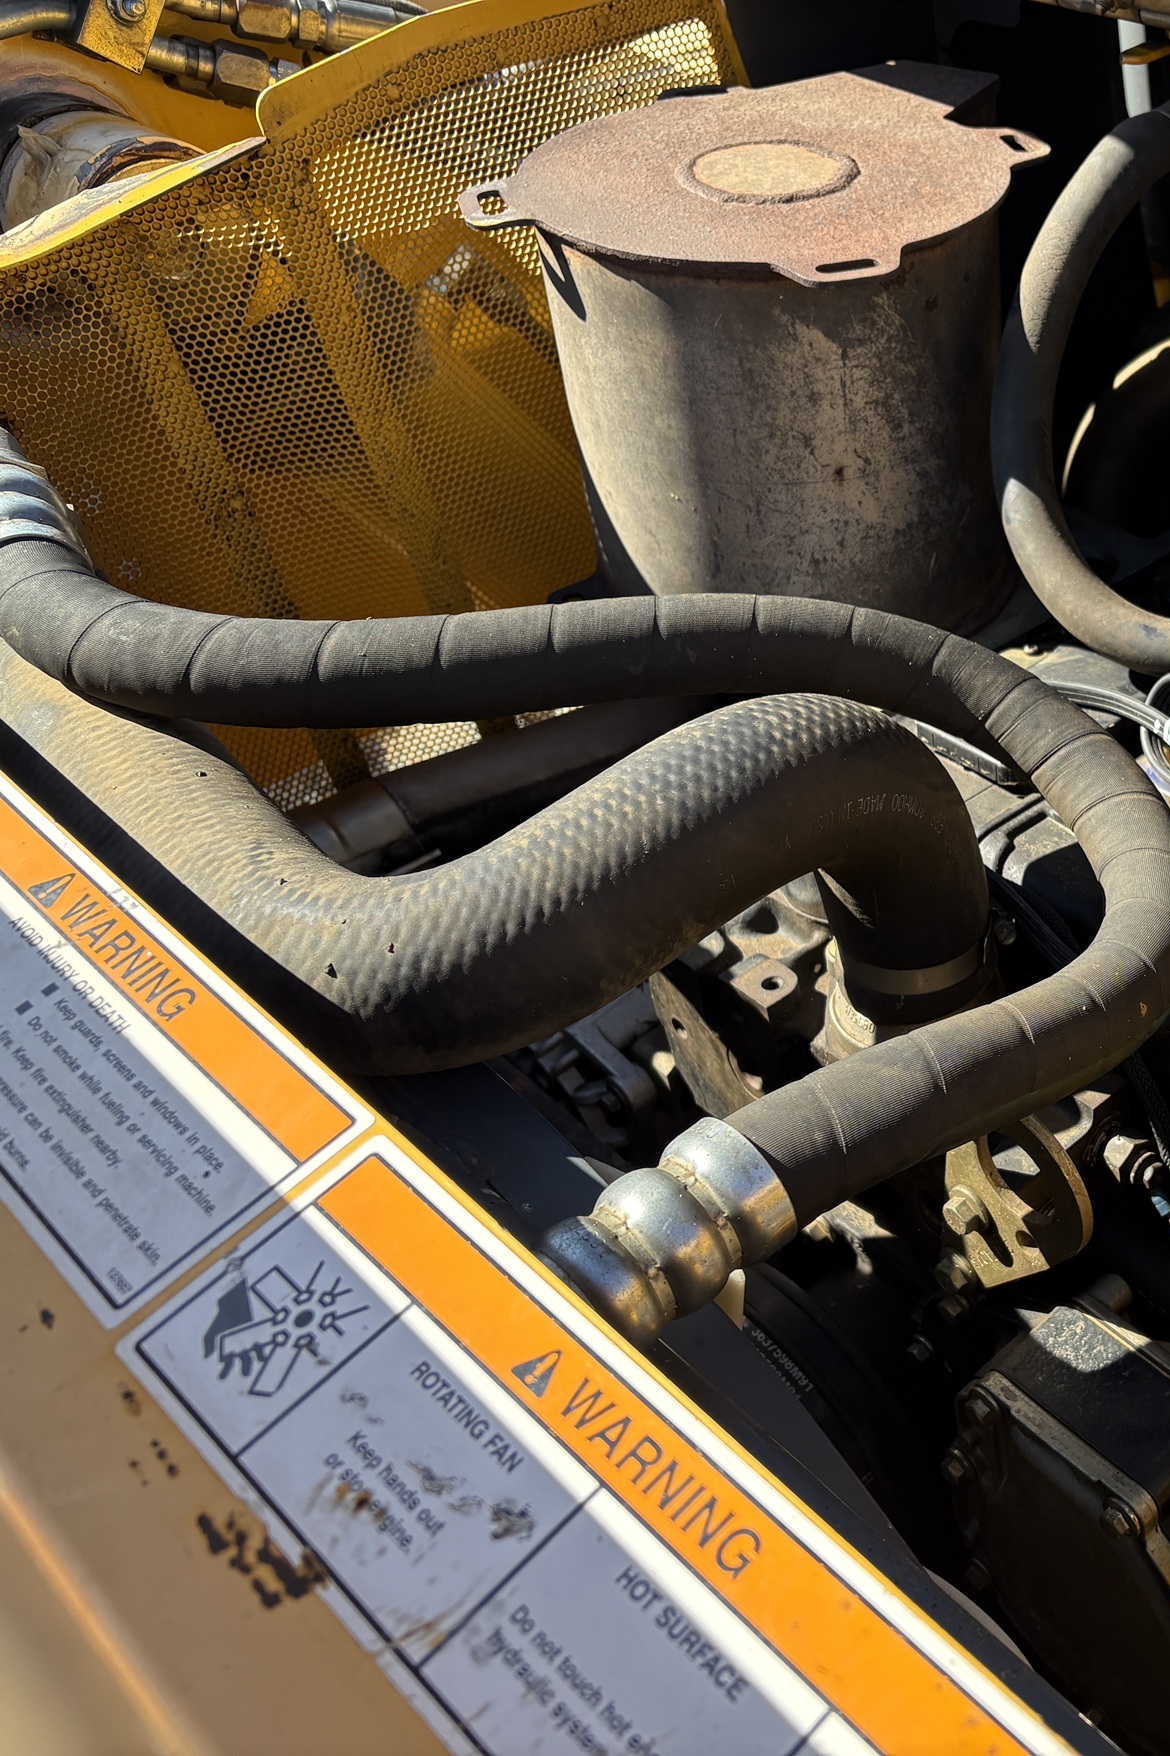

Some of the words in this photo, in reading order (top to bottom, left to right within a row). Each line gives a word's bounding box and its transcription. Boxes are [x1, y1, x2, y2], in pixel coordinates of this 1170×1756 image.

[856, 793, 887, 816] MADE
[8, 916, 43, 948] AVOID
[36, 943, 80, 982] INJURY
[72, 979, 95, 1000] OR
[88, 997, 131, 1035] DEATH
[60, 893, 196, 1023] WARNING
[11, 1046, 35, 1071] Keep
[30, 1067, 48, 1087] fire
[44, 1084, 95, 1136] extinguisher
[89, 1133, 123, 1169] nearby.
[27, 1015, 43, 1032] Do
[40, 1030, 58, 1047] not
[53, 1044, 82, 1073] smoke
[78, 1069, 103, 1096] while
[100, 1091, 130, 1127] fueling
[136, 1132, 179, 1178] servicing
[54, 997, 77, 1022] Keep
[70, 1019, 104, 1052] guards,
[102, 1049, 137, 1083] screens
[132, 1079, 156, 1100] and
[150, 1098, 190, 1136] windows
[0, 1077, 28, 1114] ressure
[24, 1112, 43, 1131] can
[38, 1126, 55, 1144] be
[50, 1139, 87, 1181] invisible
[82, 1176, 107, 1199] and
[95, 1195, 141, 1242] penetrate
[324, 1453, 345, 1470] or
[409, 1360, 490, 1441] ROTATING
[484, 1432, 525, 1474] FAN
[560, 1375, 762, 1581] WARNING
[345, 1430, 383, 1469] Keep
[378, 1462, 421, 1512] hands
[415, 1506, 446, 1537] out
[485, 1626, 556, 1707] hydraulic
[509, 1603, 535, 1635] Do
[531, 1630, 564, 1662] not
[557, 1654, 603, 1709] touch
[600, 1700, 633, 1739] hot
[615, 1563, 661, 1612] HOT
[656, 1604, 749, 1702] SURFACE
